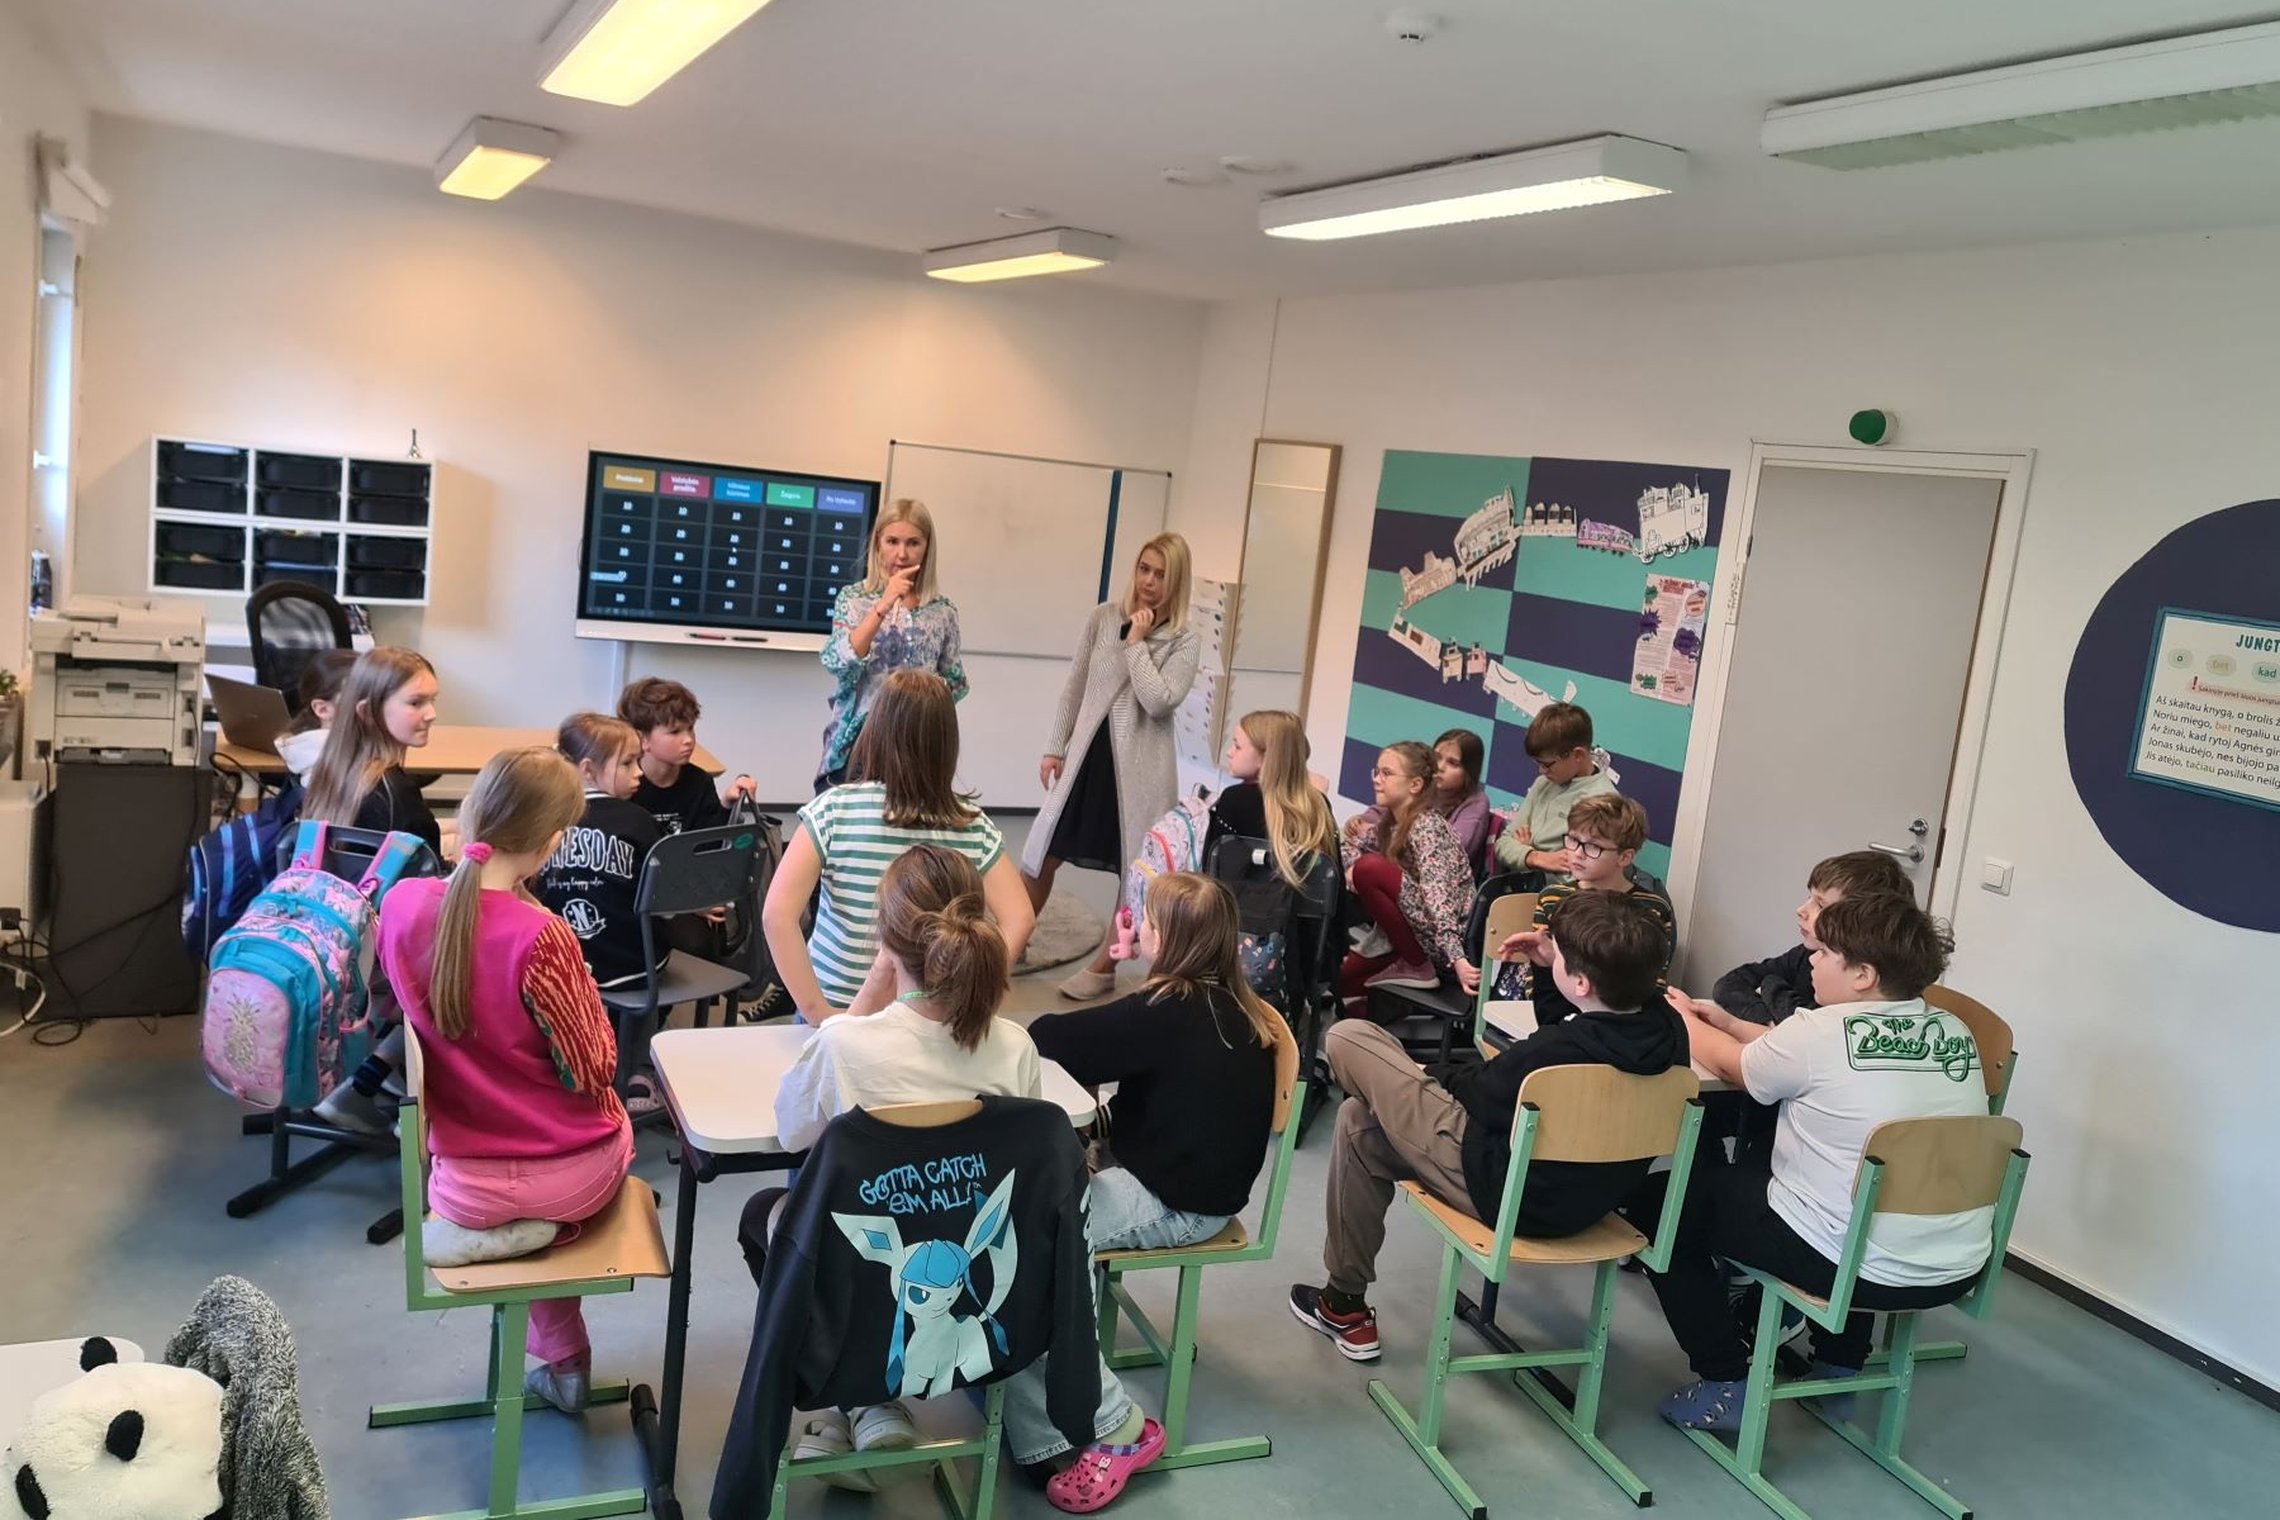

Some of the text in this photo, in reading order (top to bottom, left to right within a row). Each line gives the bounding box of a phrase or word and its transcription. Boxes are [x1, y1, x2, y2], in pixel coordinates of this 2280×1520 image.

[2236, 634, 2280, 653] JUNGT
[2258, 666, 2277, 678] kad
[2153, 709, 2178, 722] Noriu
[2180, 715, 2213, 730] miego,
[2234, 726, 2271, 740] negaliu
[2156, 695, 2167, 705] Aš
[2169, 698, 2201, 712] skaitau
[2246, 711, 2273, 725] brolis
[2148, 737, 2173, 750] Jonas
[2216, 752, 2234, 762] nes
[2236, 755, 2264, 770] bijojo
[2150, 723, 2161, 733] Ar
[2162, 725, 2186, 739] žinai,
[2189, 730, 2207, 742] kad
[2208, 735, 2232, 750] rytoj
[2233, 739, 2264, 754] Agnės
[2217, 768, 2254, 782] pasiliko
[541, 826, 634, 879] NESDAY
[571, 902, 590, 931] N
[1881, 1017, 1916, 1035] The
[859, 1152, 987, 1206] GOTTA CATCH
